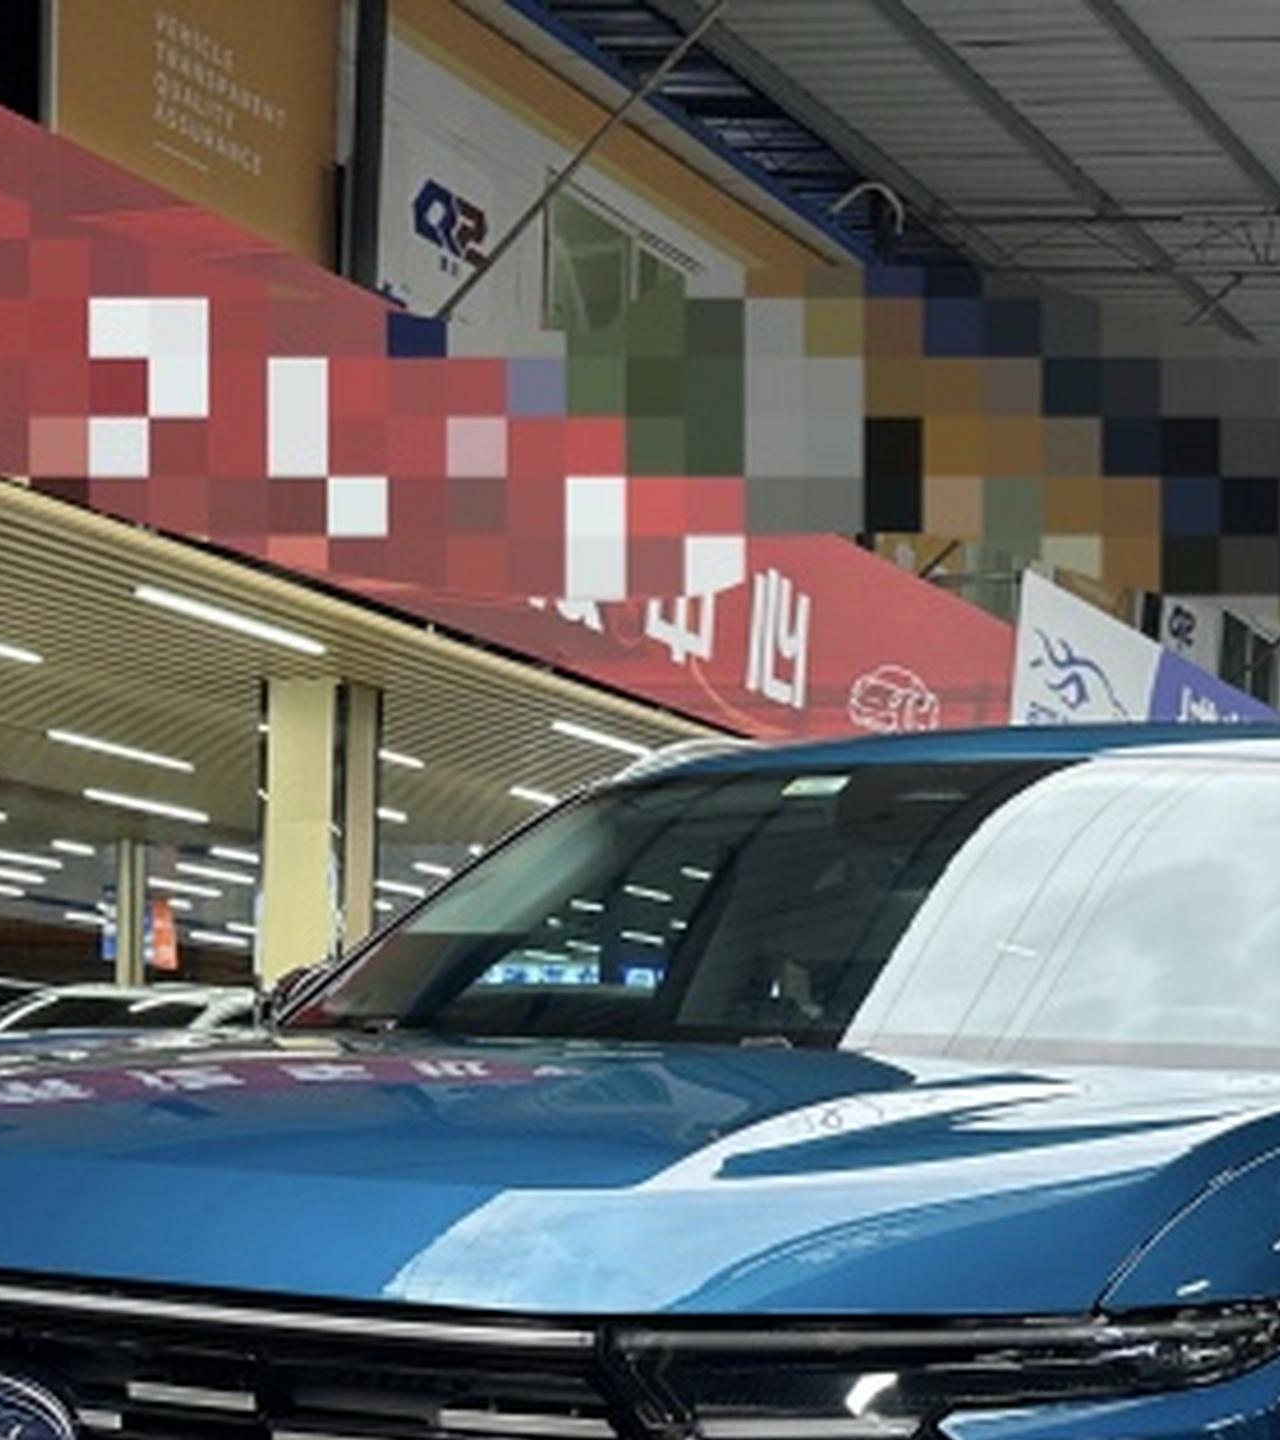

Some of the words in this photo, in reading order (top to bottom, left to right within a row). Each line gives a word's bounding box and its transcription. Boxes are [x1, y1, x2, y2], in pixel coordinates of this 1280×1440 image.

[154, 8, 234, 76] VEHICLE
[153, 71, 234, 130] QUALITY
[156, 40, 287, 130] TRANSPARENT
[153, 101, 262, 177] ASSURANCE
